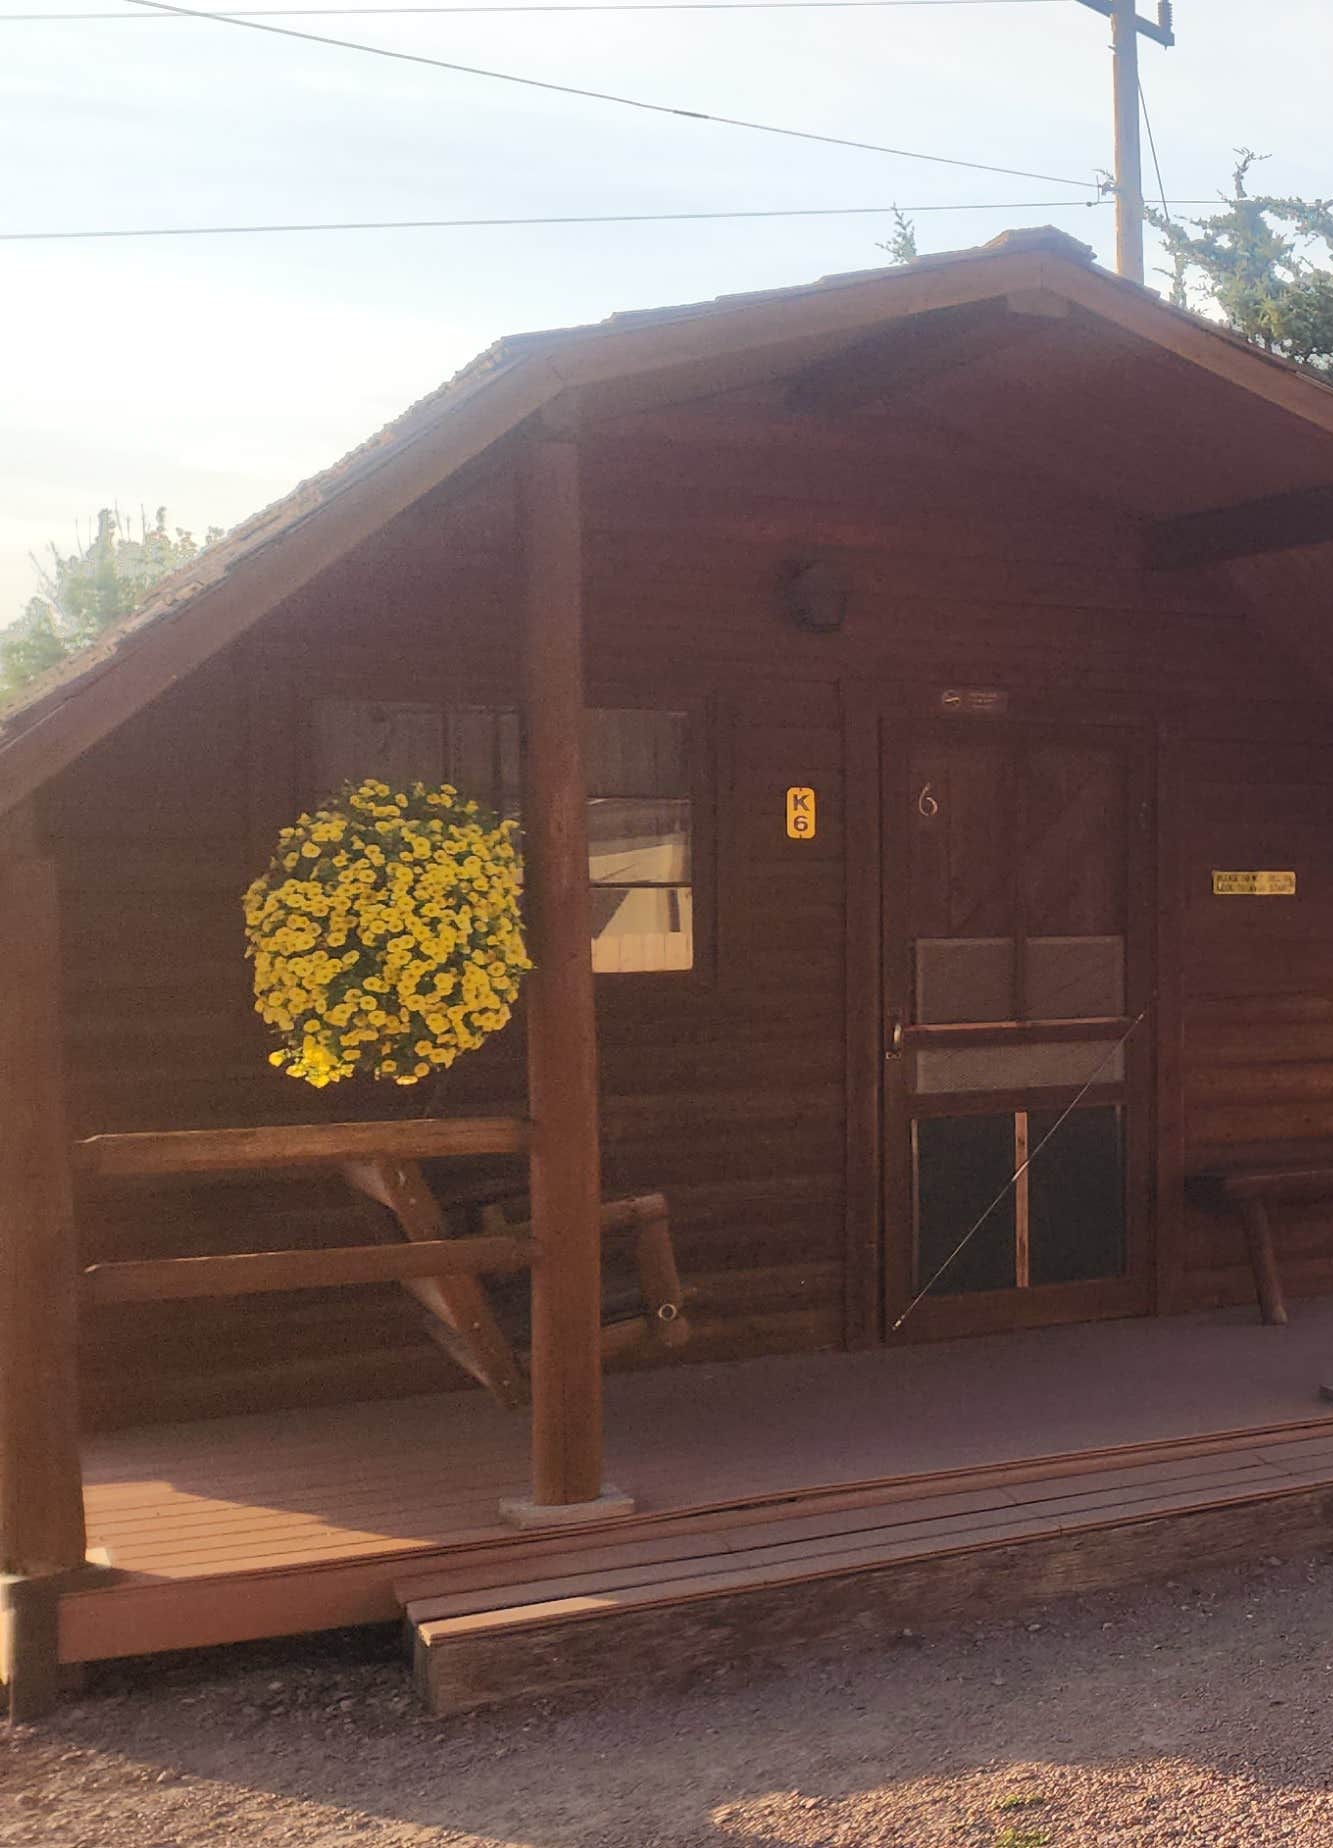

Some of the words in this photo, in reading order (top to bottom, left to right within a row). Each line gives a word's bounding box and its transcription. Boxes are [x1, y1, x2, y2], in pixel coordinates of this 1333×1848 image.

[792, 794, 810, 812] K
[919, 783, 938, 816] 6
[793, 815, 809, 832] 6
